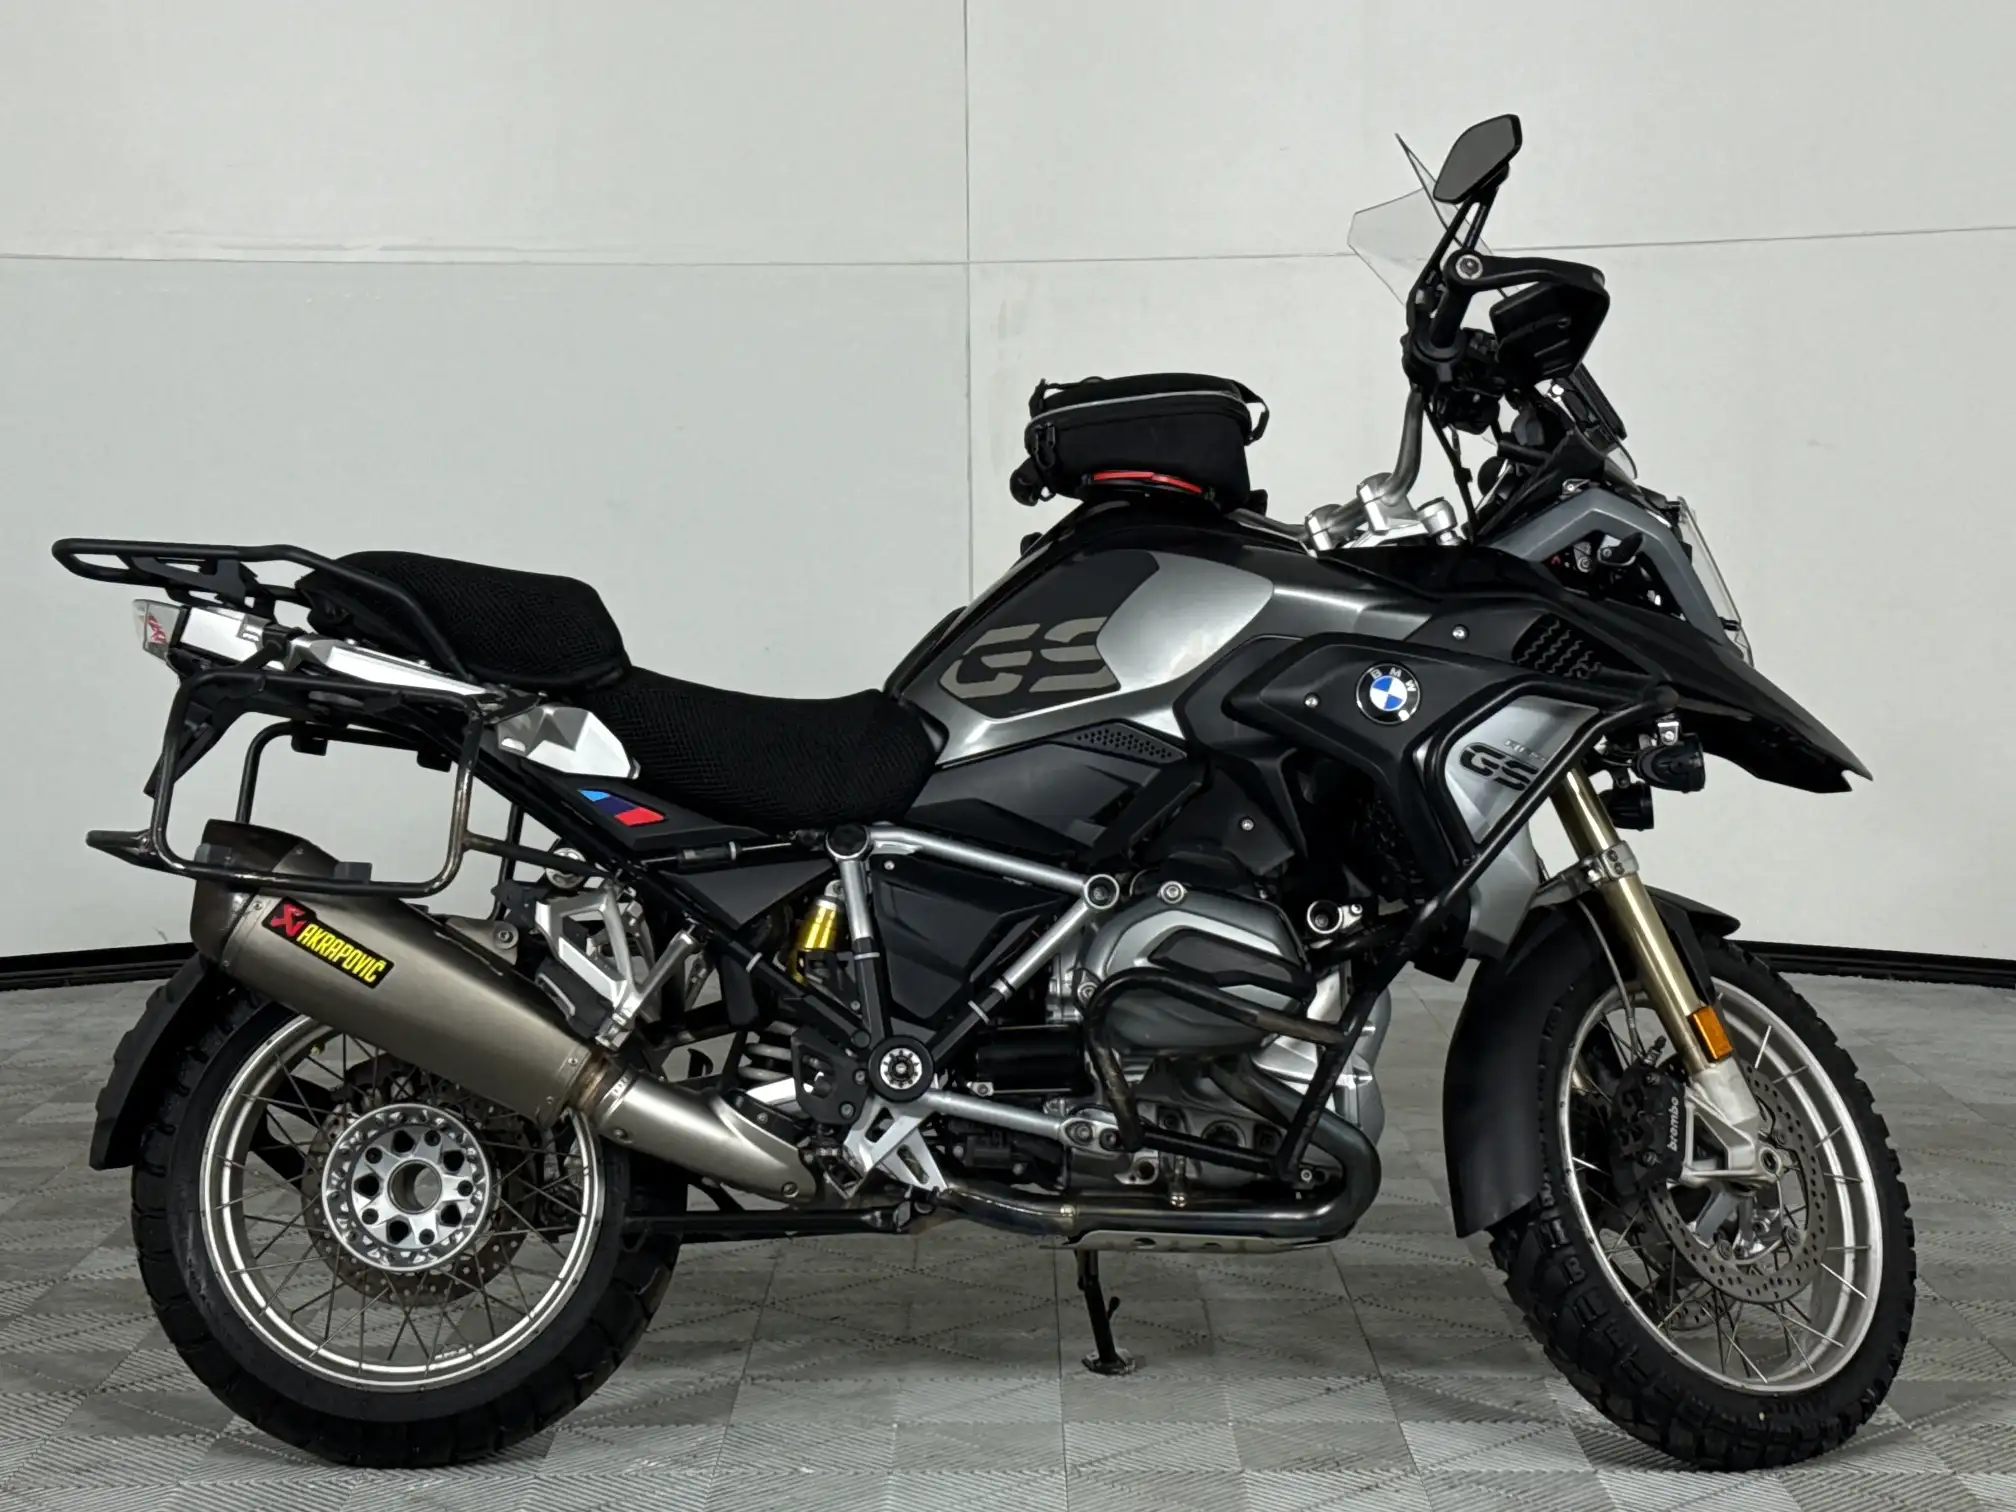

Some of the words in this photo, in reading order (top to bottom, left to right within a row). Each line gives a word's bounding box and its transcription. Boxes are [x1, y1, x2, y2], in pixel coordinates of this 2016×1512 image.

[940, 617, 1117, 698] GS
[1370, 667, 1416, 692] BMW
[1460, 743, 1541, 791] GS
[1666, 1096, 1679, 1152] brembo
